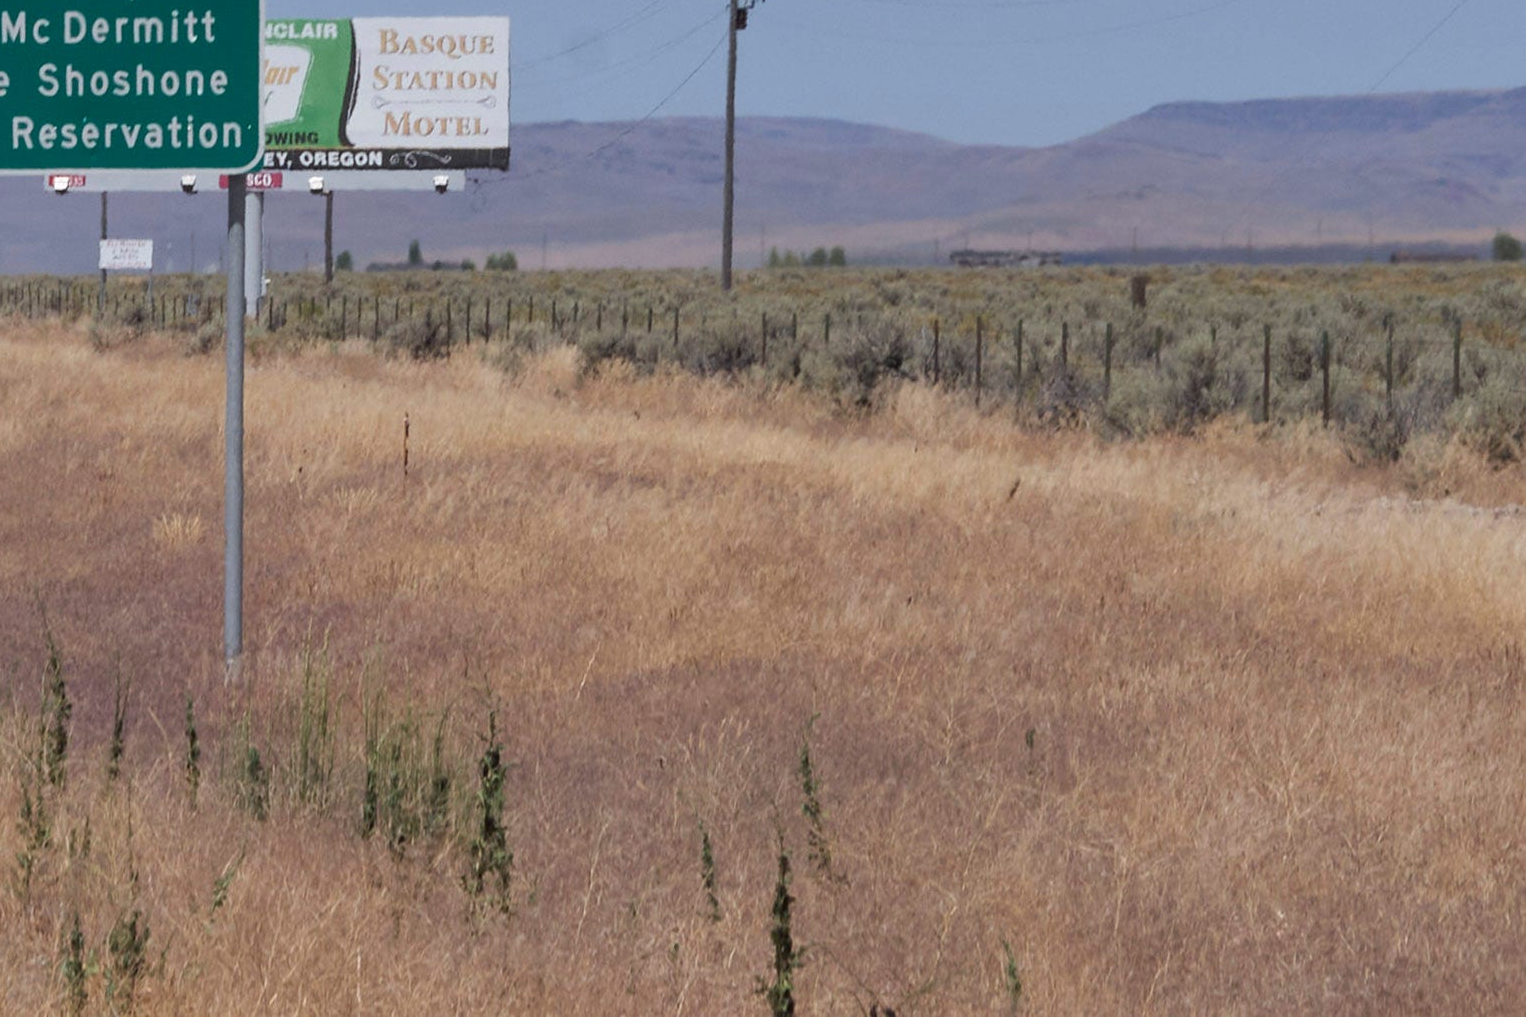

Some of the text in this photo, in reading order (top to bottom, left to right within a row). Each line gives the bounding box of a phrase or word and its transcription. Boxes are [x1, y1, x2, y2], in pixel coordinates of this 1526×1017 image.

[64, 10, 216, 44] Dermitt
[378, 27, 495, 59] BASQUE
[38, 63, 228, 97] Shoshone
[373, 64, 498, 90] STATION
[12, 115, 242, 150] Reservation
[382, 110, 489, 136] MOTEL
[299, 150, 383, 167] OREGON
